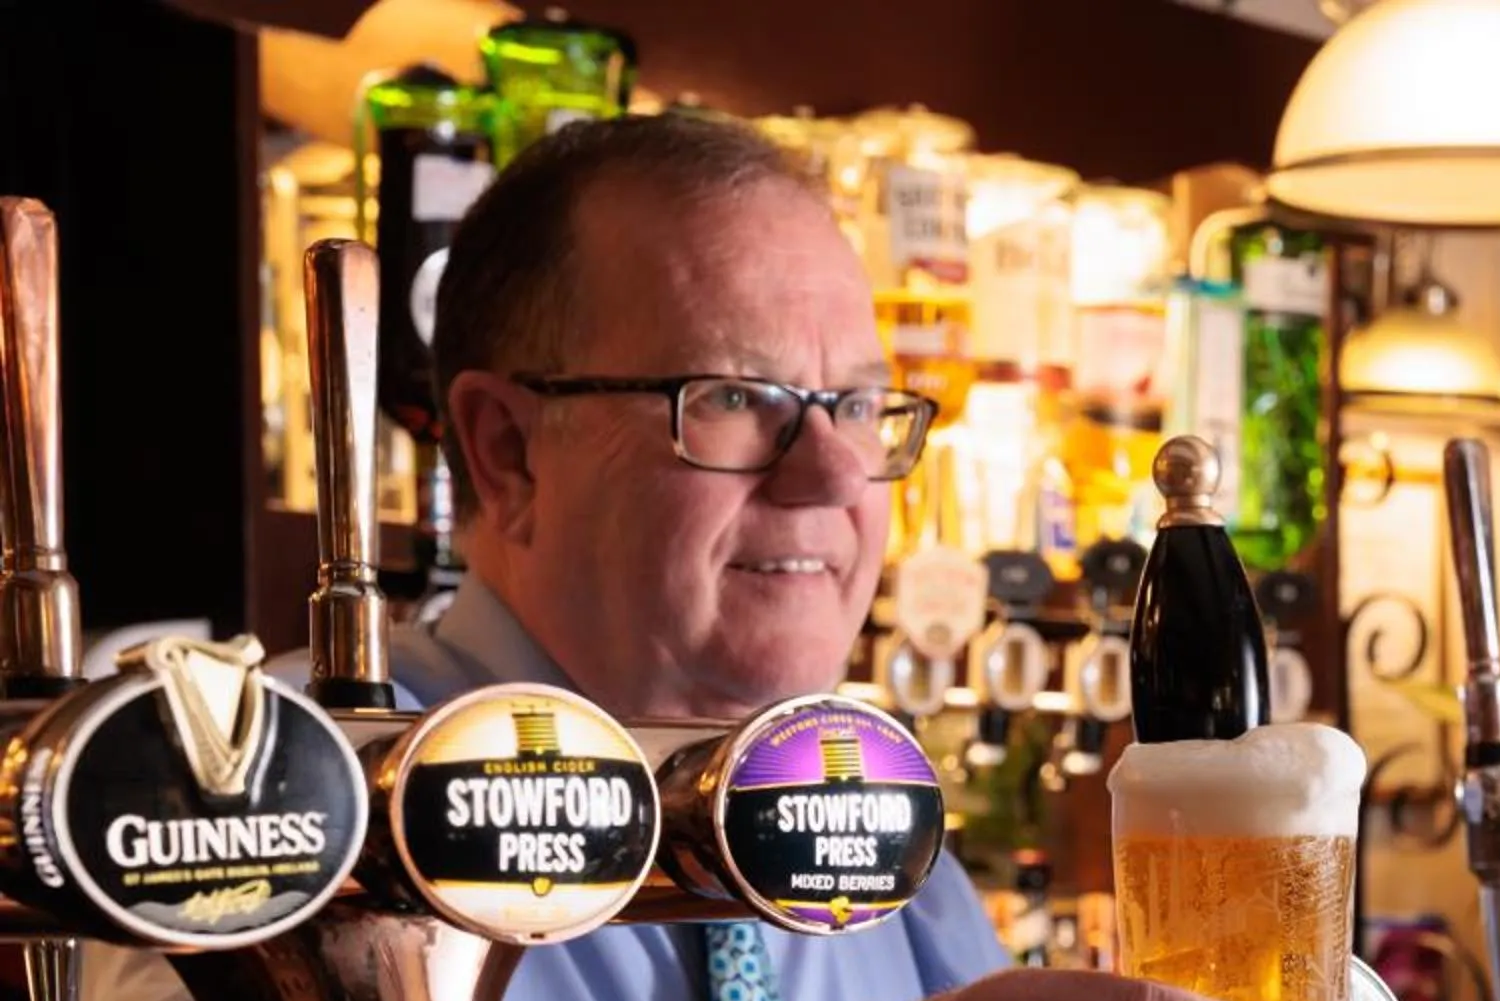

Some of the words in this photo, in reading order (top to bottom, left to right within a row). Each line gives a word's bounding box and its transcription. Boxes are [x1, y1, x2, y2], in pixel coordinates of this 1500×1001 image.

[484, 760, 547, 775] ENGLISH
[552, 759, 596, 774] CIDER
[446, 776, 632, 828] STOWFORD
[776, 793, 913, 834] STOWFORD
[106, 812, 326, 868] GUINNESS
[499, 832, 587, 874] PRESS
[814, 835, 879, 867] PRESS
[791, 873, 835, 890] MIXED
[838, 874, 896, 892] BERRIES
